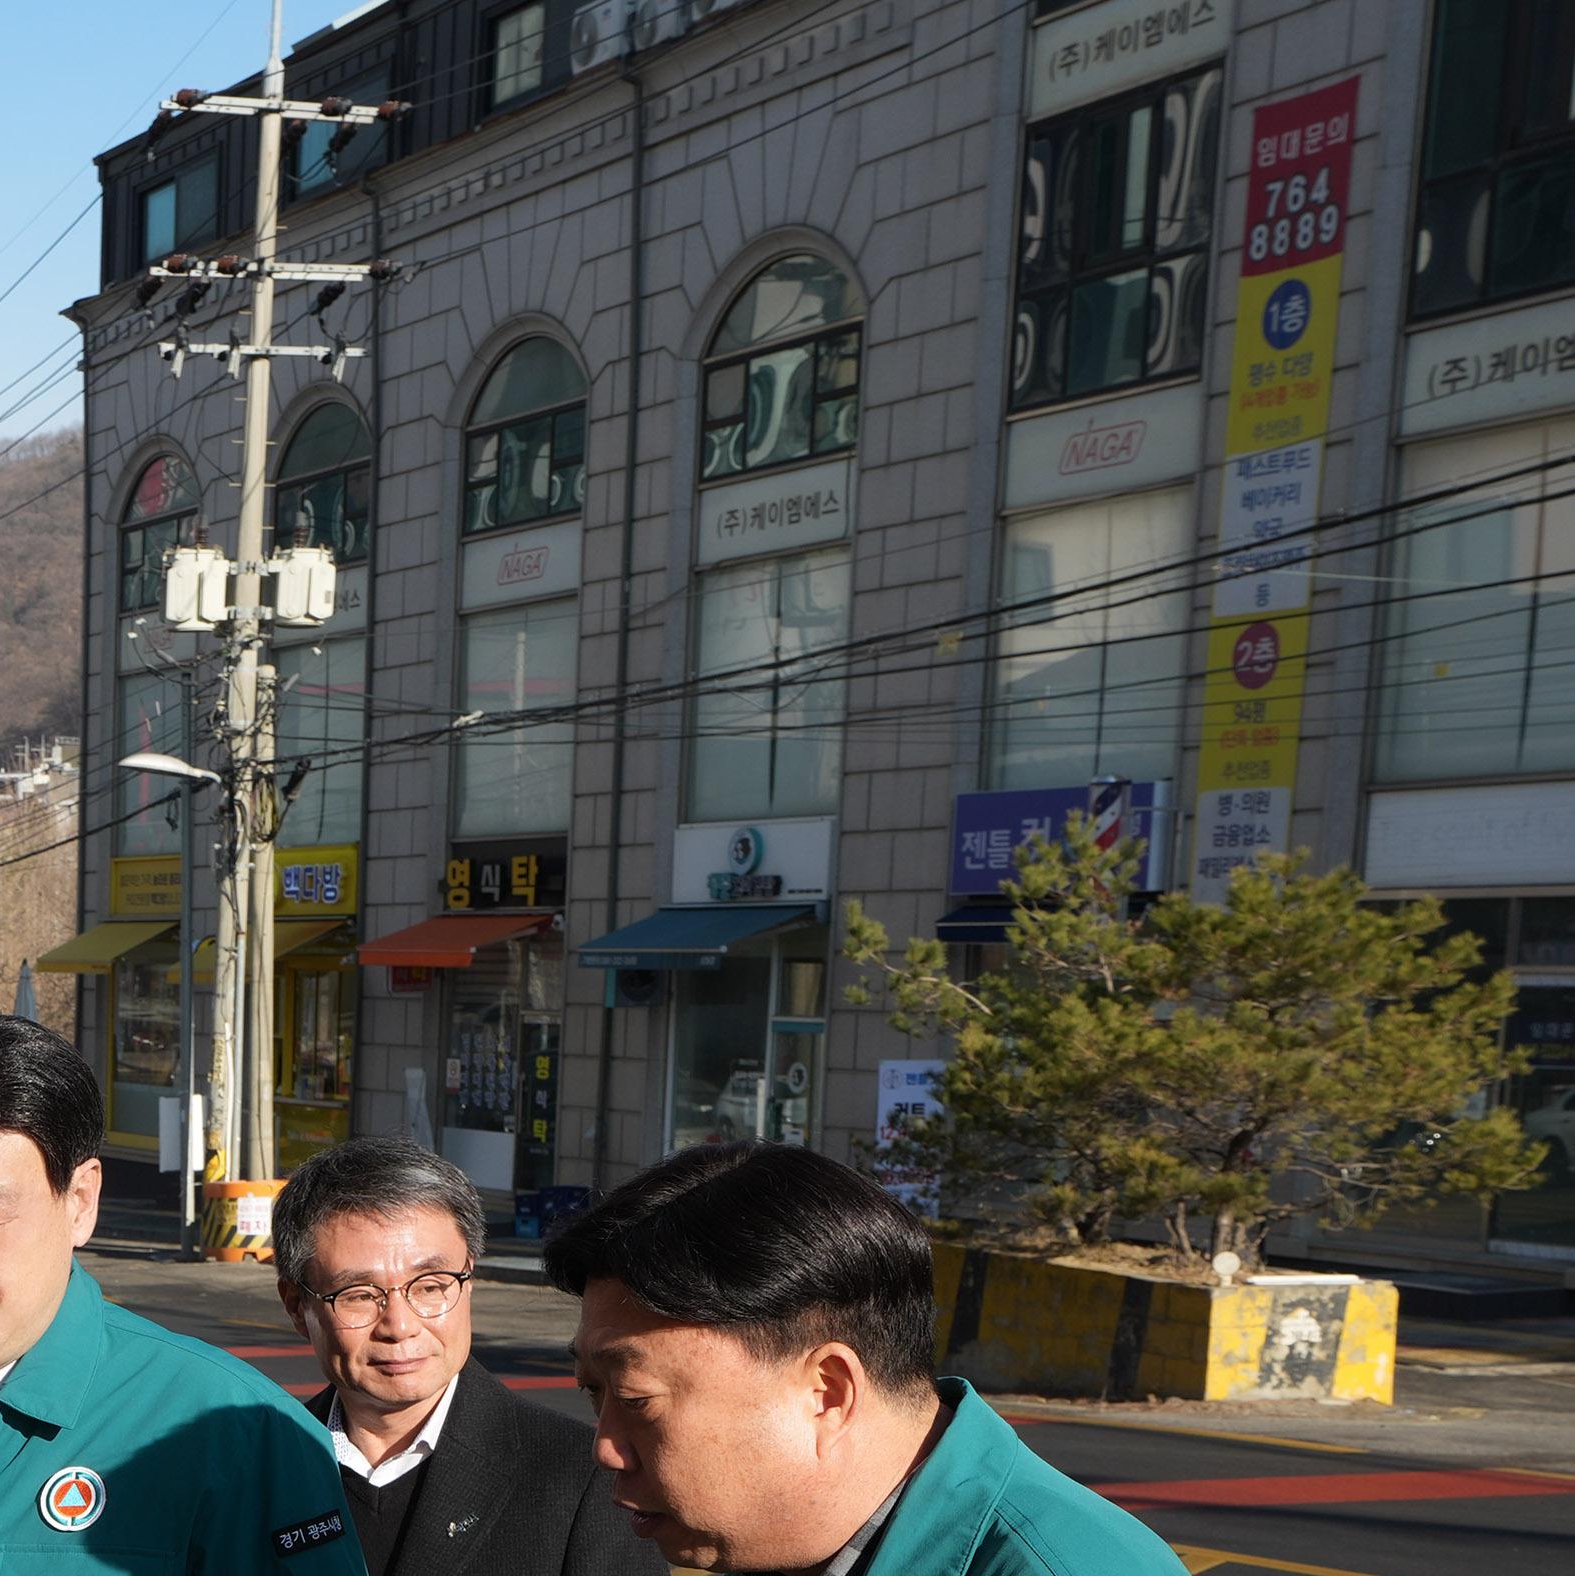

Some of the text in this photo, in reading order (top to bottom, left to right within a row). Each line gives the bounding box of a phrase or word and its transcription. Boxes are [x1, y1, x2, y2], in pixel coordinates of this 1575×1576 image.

[1048, 0, 1217, 82] (주)케이엠에스
[1257, 113, 1350, 168] 임대문의
[1265, 167, 1330, 218] 764
[1250, 205, 1339, 260] 8889
[1268, 294, 1308, 334] 1층
[1062, 418, 1137, 467] NAGA
[1236, 447, 1313, 480] 패스트푸드
[717, 489, 840, 539] (주)케이엠에스
[1241, 482, 1303, 512] 베이커리
[501, 544, 545, 580] NAGA
[1235, 636, 1277, 674] 2층
[1212, 823, 1272, 848] 금융업소
[279, 1528, 306, 1549] 경기
